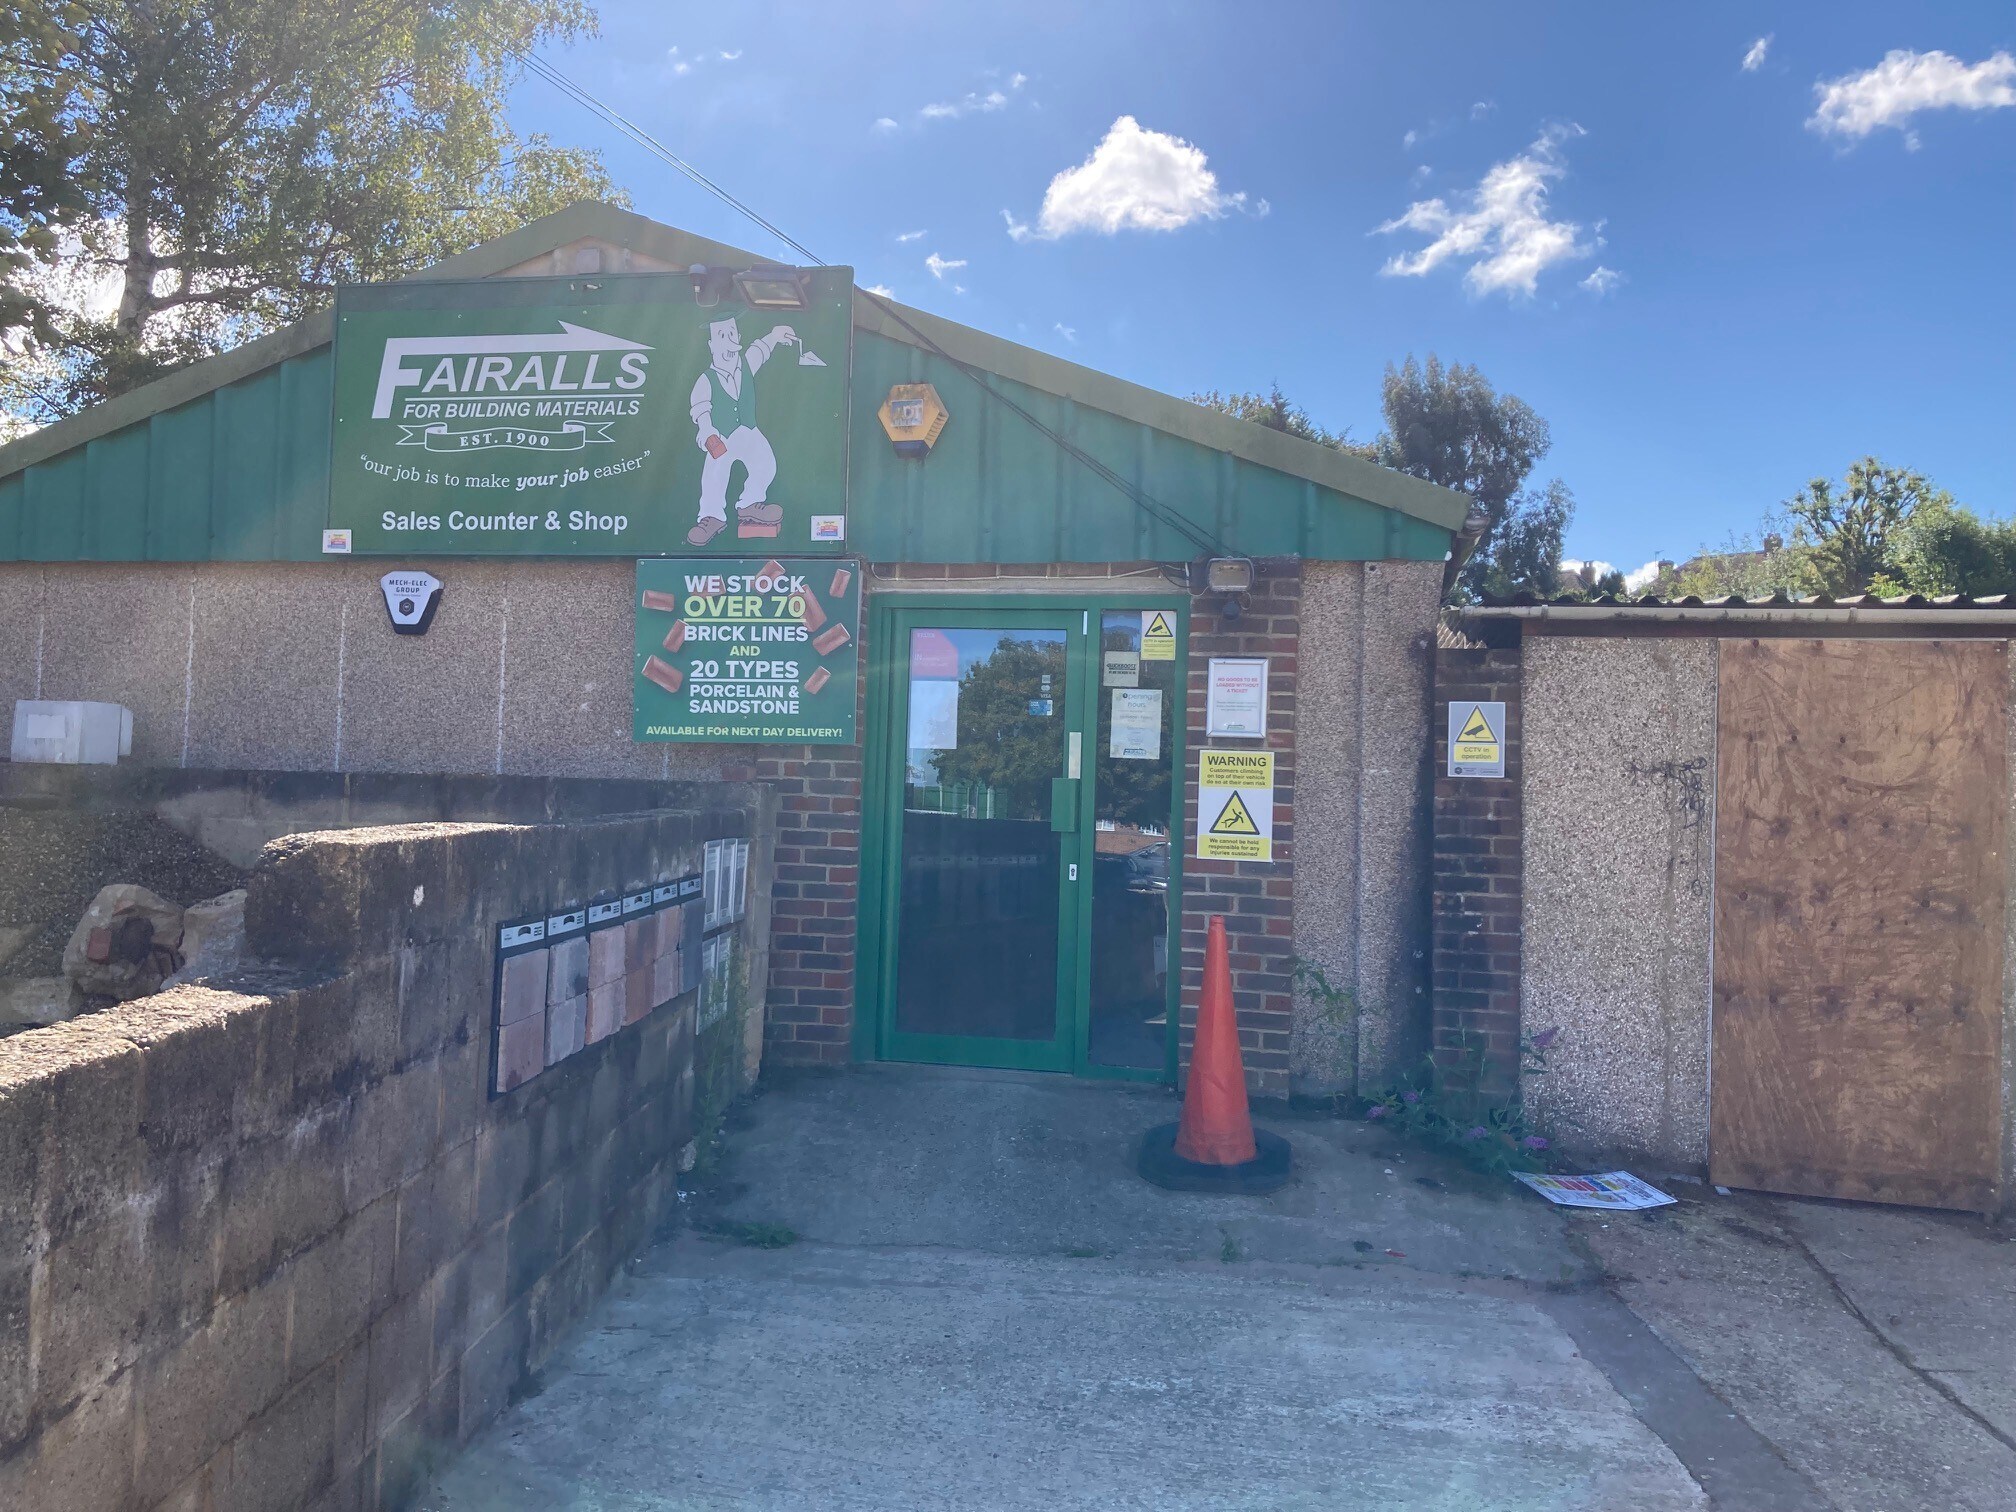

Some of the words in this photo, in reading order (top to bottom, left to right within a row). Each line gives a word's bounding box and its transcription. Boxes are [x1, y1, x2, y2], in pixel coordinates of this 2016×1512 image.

[372, 320, 655, 418] FAIRALLS
[403, 403, 440, 419] FOR
[445, 401, 530, 418] BUILDING
[535, 400, 640, 417] MATERIALS
[460, 432, 498, 447] EST.
[505, 432, 550, 447] 1900
[393, 464, 420, 482] job
[425, 469, 439, 484] is
[445, 472, 460, 486] to
[465, 473, 510, 488] make
[516, 471, 558, 491] your
[560, 467, 590, 487] job
[382, 510, 441, 530] Sales
[448, 510, 539, 531] Counter
[544, 510, 562, 531] &
[568, 510, 628, 535] Shop
[684, 575, 720, 593] WE
[727, 575, 806, 594] STOCK
[684, 596, 763, 618] OVER
[771, 596, 806, 618] 70
[684, 625, 746, 642] BRICK
[751, 626, 809, 642] LINES
[730, 645, 761, 657] AND
[690, 660, 719, 678] 20
[726, 660, 799, 679] TYPES
[689, 684, 784, 698] PORCELAIN
[788, 685, 800, 698] &
[689, 700, 800, 715] SANDSTONE
[646, 725, 704, 736] AVAILABLE
[707, 726, 729, 736] FOR
[731, 727, 760, 736] NEXT
[762, 727, 785, 737] DAY
[787, 728, 842, 737] DELIVERY!
[1207, 755, 1267, 767] WARNING
